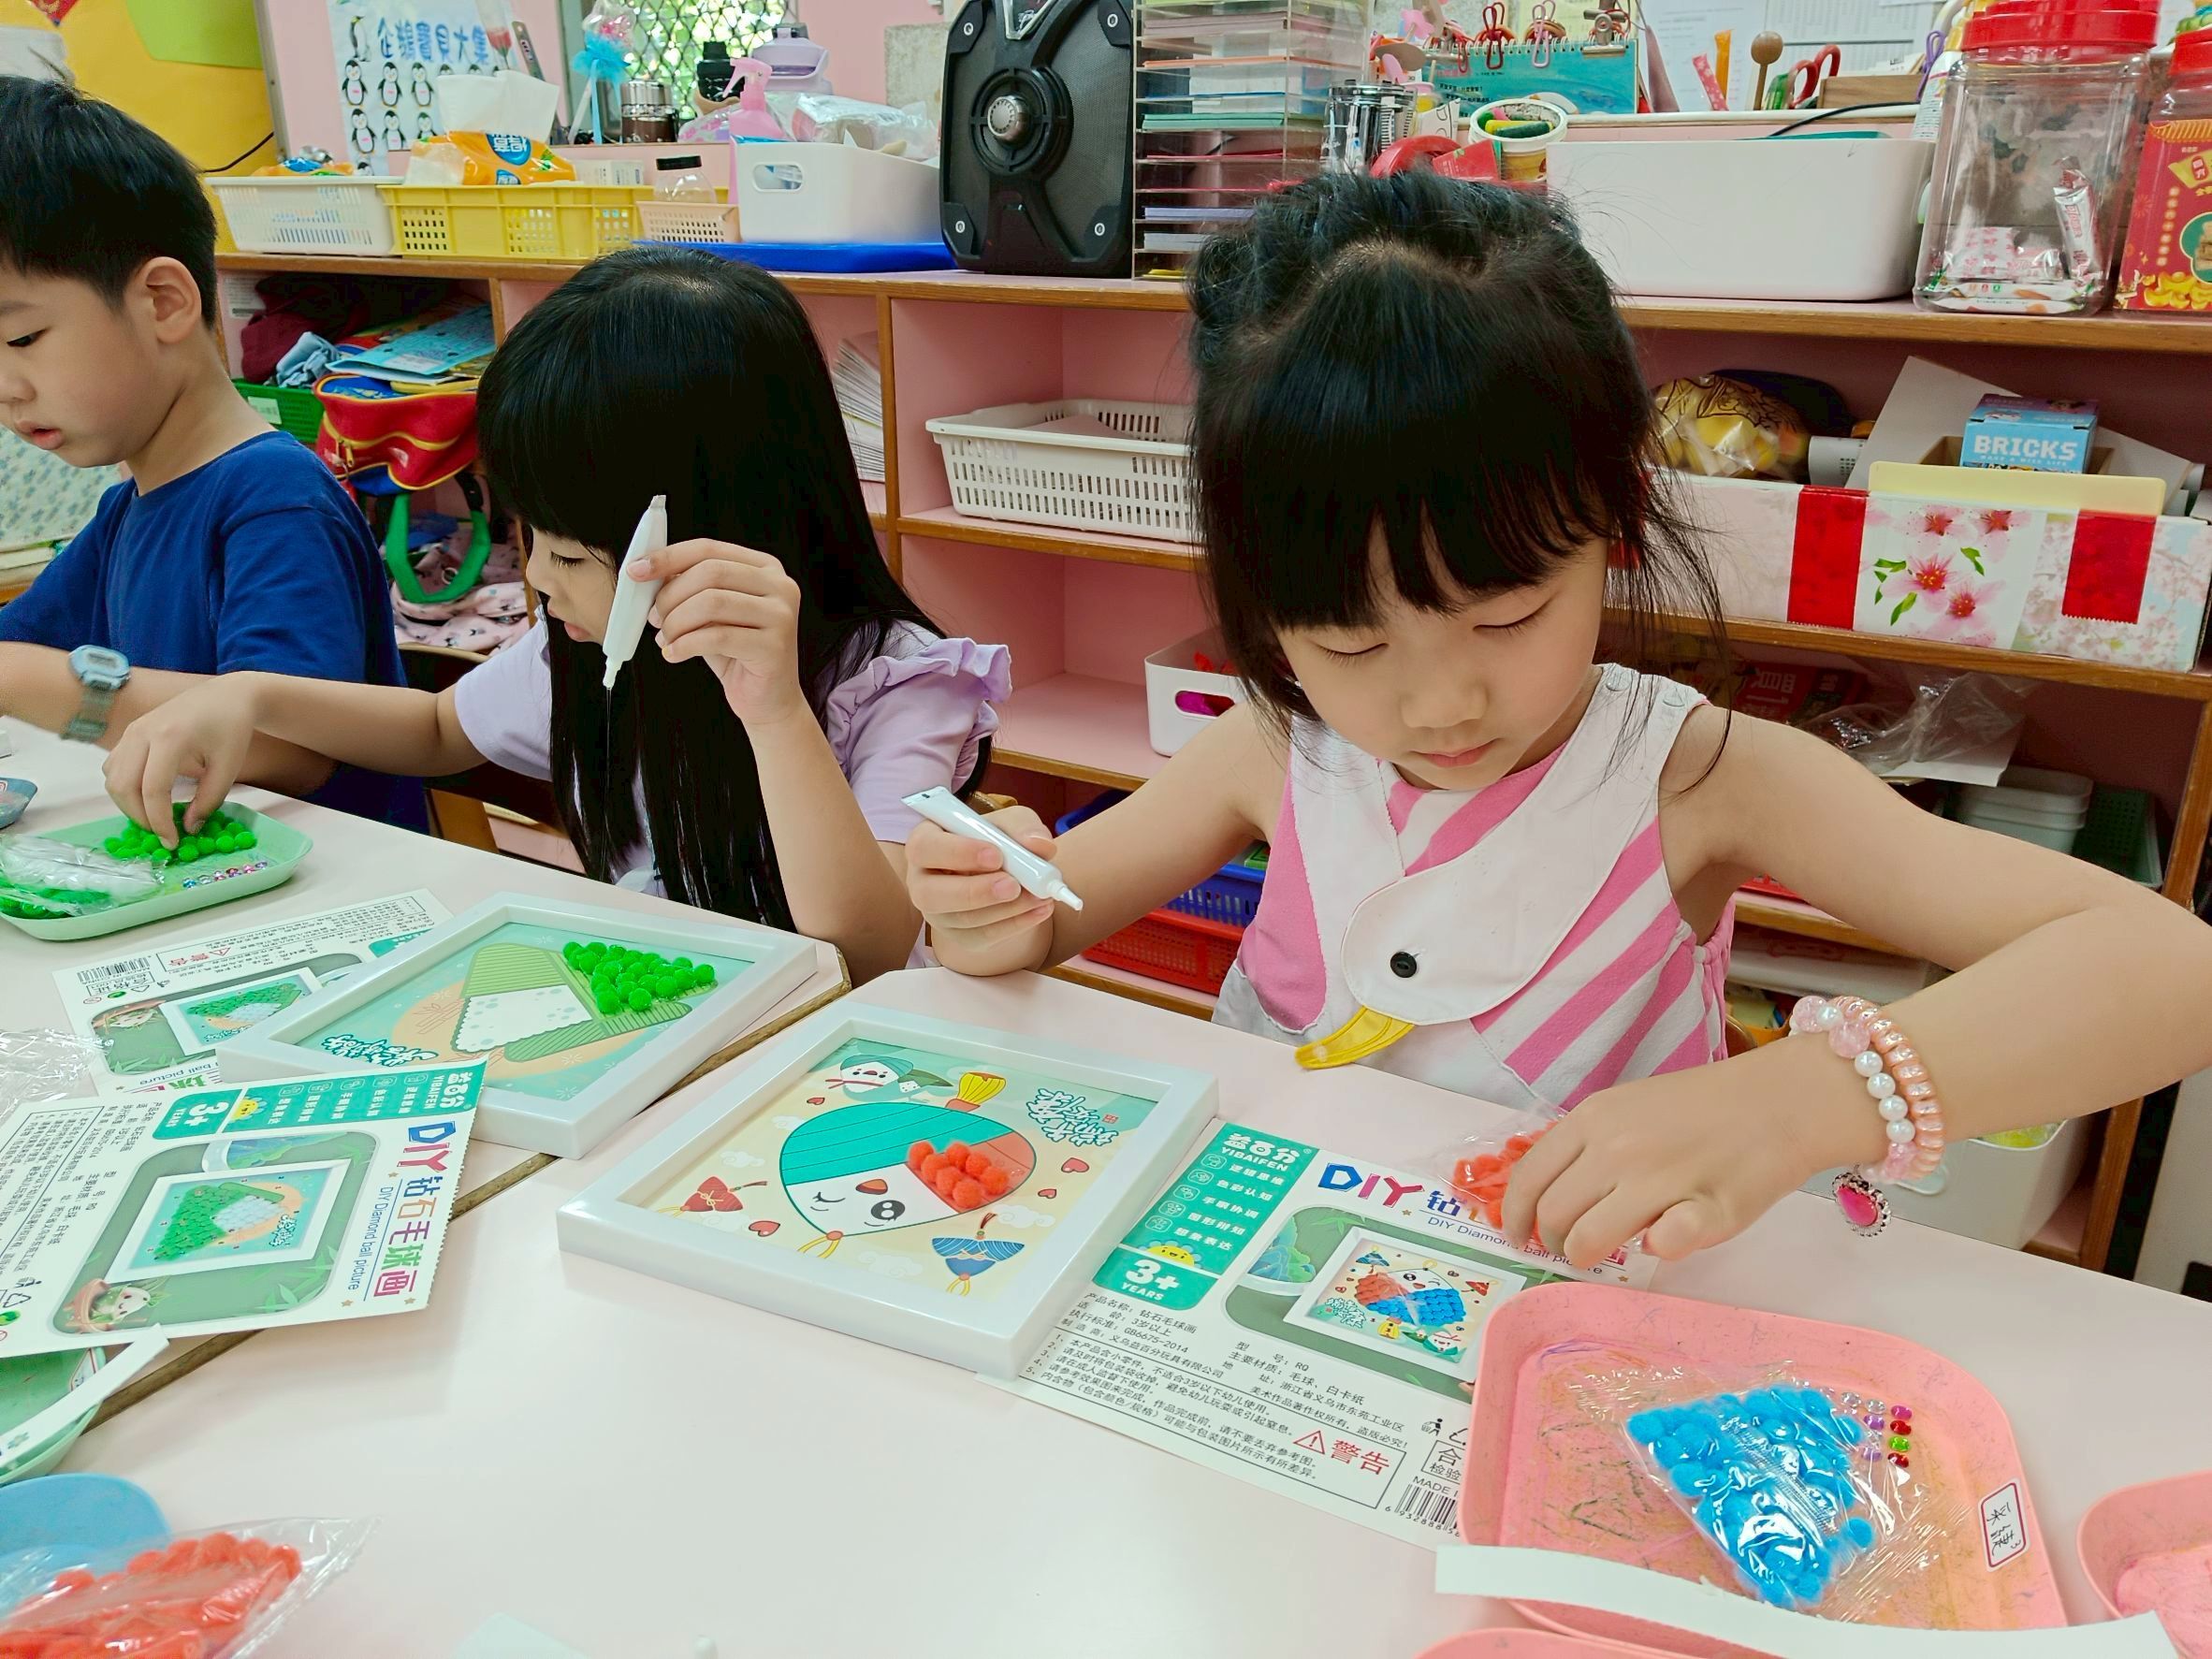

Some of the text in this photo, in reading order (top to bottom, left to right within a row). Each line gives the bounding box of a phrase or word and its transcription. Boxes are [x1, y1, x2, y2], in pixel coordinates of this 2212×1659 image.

[1973, 434, 2077, 461] BRICKS
[139, 1070, 184, 1085] picture
[189, 1063, 211, 1074] ball
[424, 1075, 445, 1109] YIBAIFEN
[184, 1101, 229, 1128] 3+
[397, 1120, 457, 1172] DIY
[1220, 1146, 1288, 1171] YIBAIFEN
[1318, 1163, 1425, 1208] DIY
[348, 1186, 394, 1290] DIY Diamond ball picture
[373, 1175, 444, 1297] 钻石毛球画
[1428, 1216, 1455, 1230] DIY
[1523, 1244, 1550, 1259] ball
[1126, 1259, 1180, 1290] 3+
[1121, 1281, 1164, 1302] YEARS
[1331, 1439, 1390, 1476] 警告
[1413, 1476, 1451, 1495] MADE
